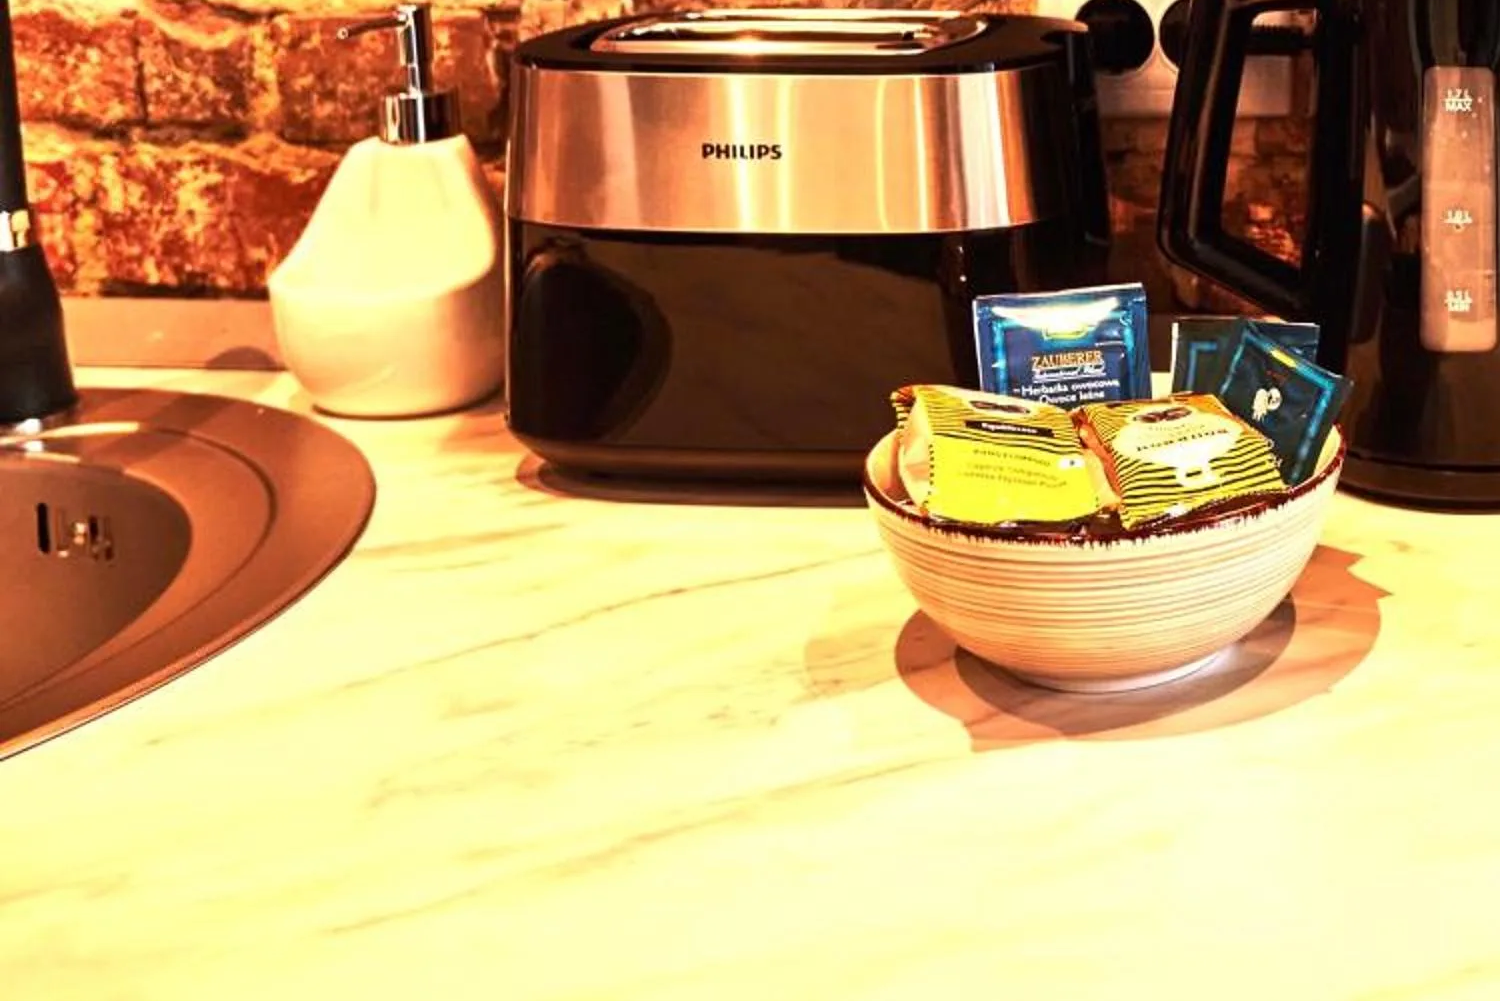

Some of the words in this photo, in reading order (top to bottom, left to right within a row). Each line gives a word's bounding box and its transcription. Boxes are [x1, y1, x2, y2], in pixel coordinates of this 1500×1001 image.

[1445, 100, 1472, 112] MAX
[701, 142, 782, 160] PHILIPS
[1031, 350, 1103, 369] ZAUBERER
